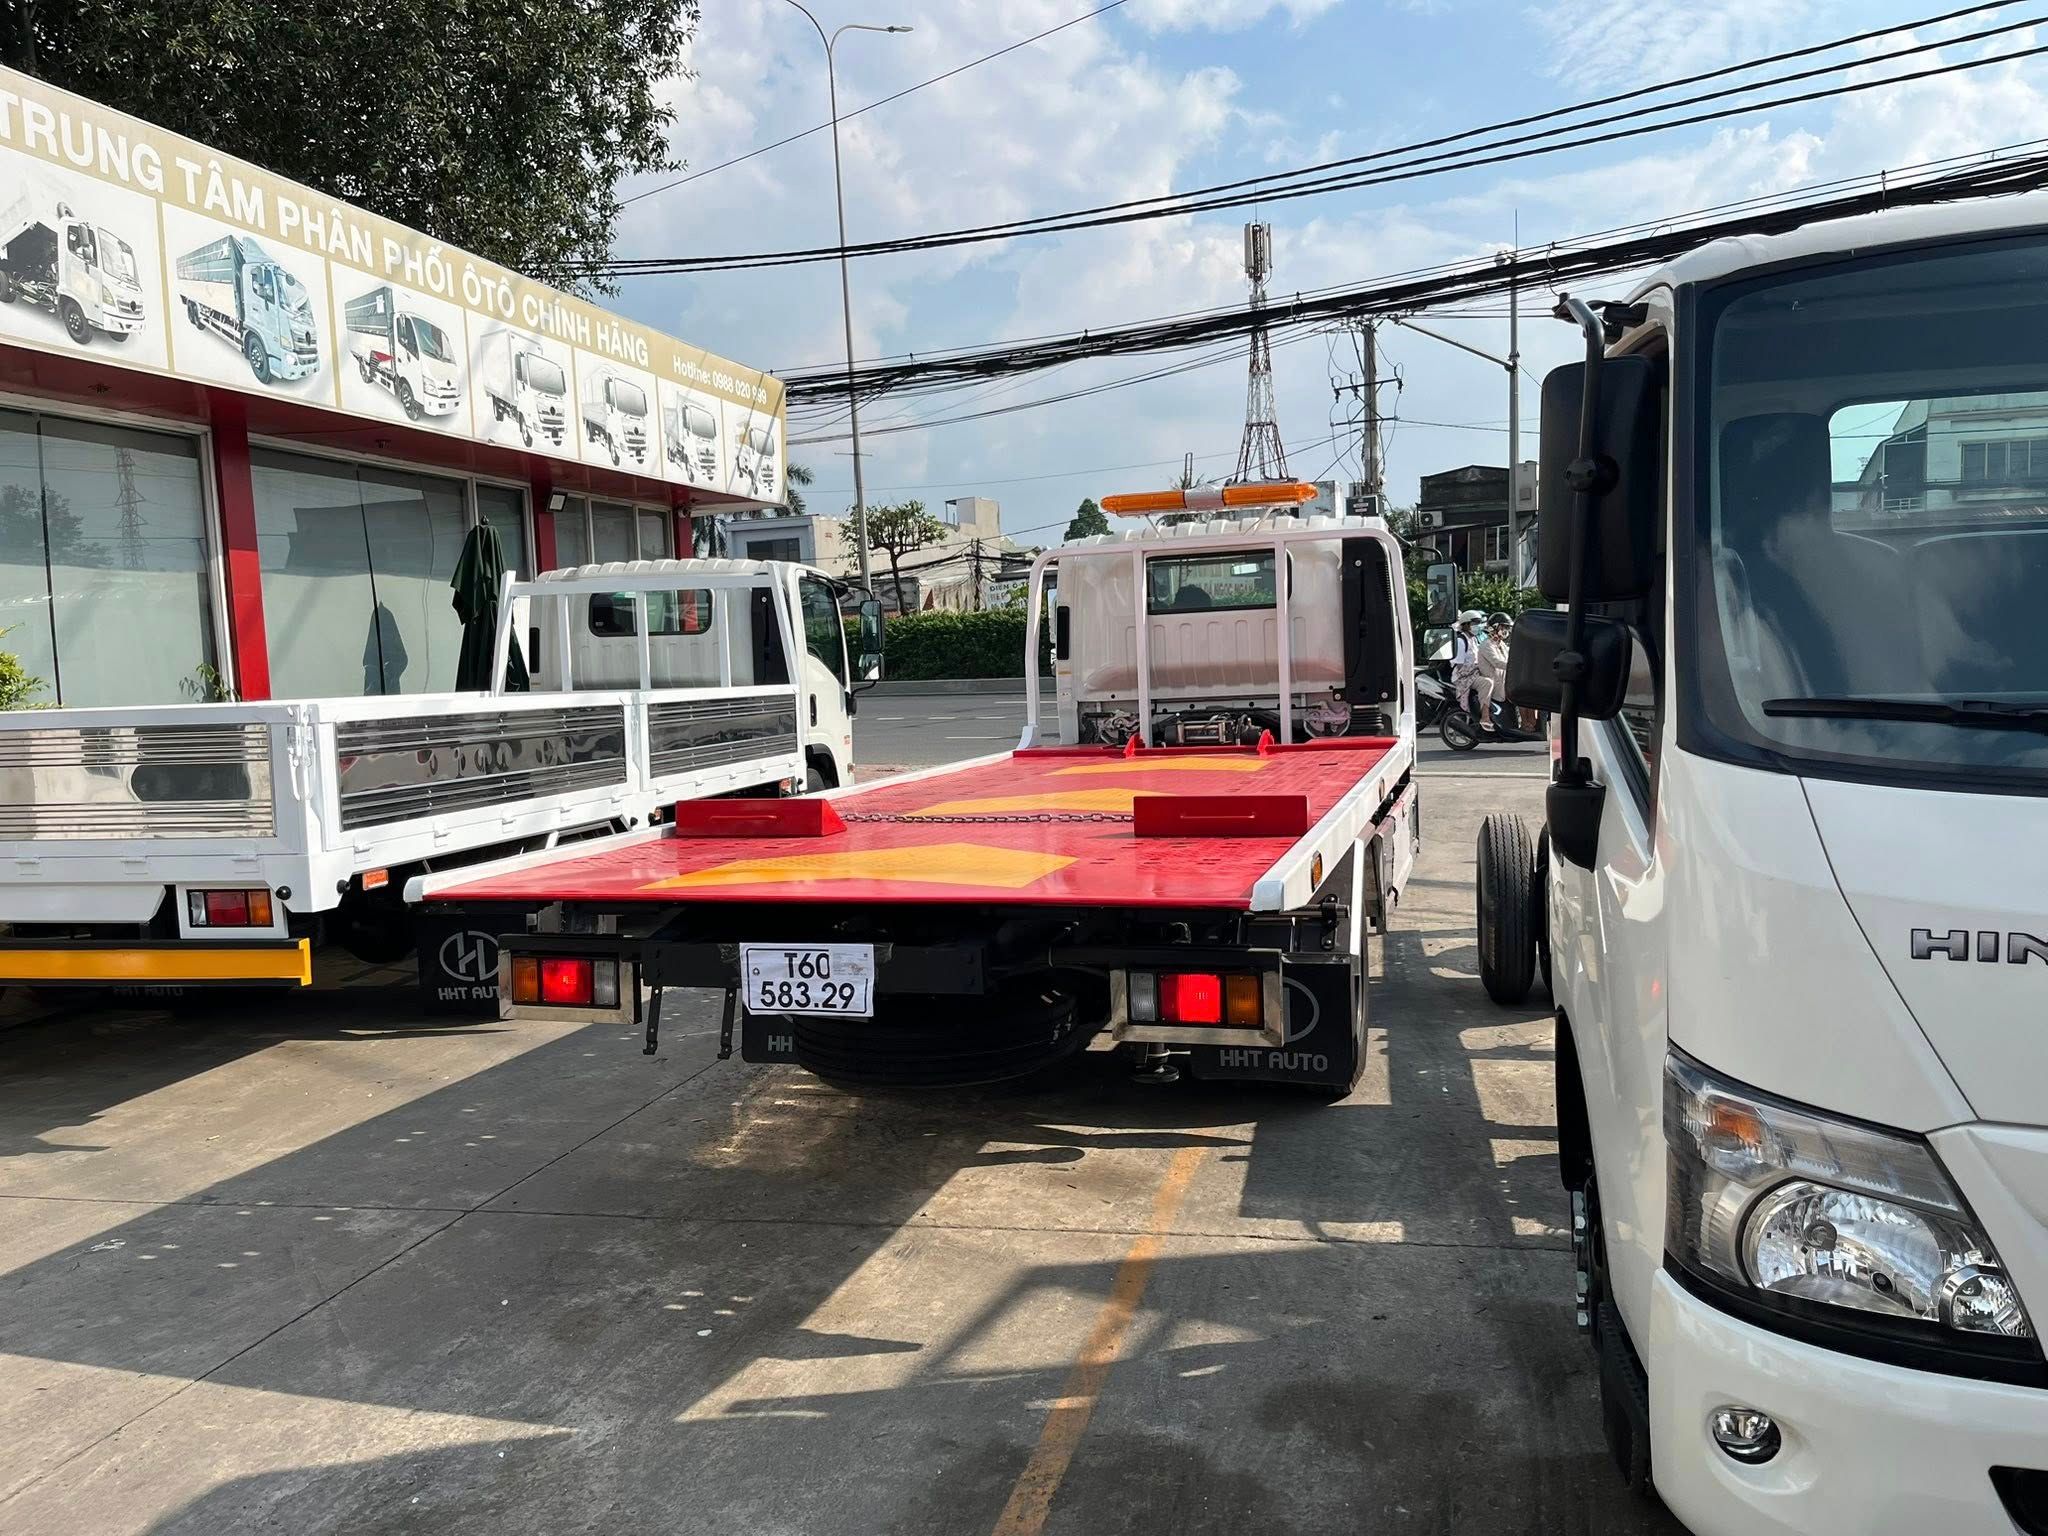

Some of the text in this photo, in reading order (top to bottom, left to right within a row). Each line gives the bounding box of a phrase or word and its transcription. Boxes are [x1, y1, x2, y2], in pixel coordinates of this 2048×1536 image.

[0, 89, 165, 194] TRUNG
[175, 156, 266, 230] TÂM
[277, 198, 375, 269] PHÂN
[382, 236, 455, 298] PHỐI
[462, 261, 516, 319] ÔTÔ
[522, 293, 592, 347] CHÍNH
[673, 354, 712, 385] Hotline:
[712, 370, 734, 393] 0988
[735, 380, 751, 399] 020
[1909, 927, 2048, 965] HIN
[783, 952, 831, 980] T60
[438, 985, 500, 1001] HHT AUT
[760, 980, 856, 1010] 583.29
[767, 1034, 793, 1053] HH
[1220, 1049, 1328, 1072] HHT AUTO
